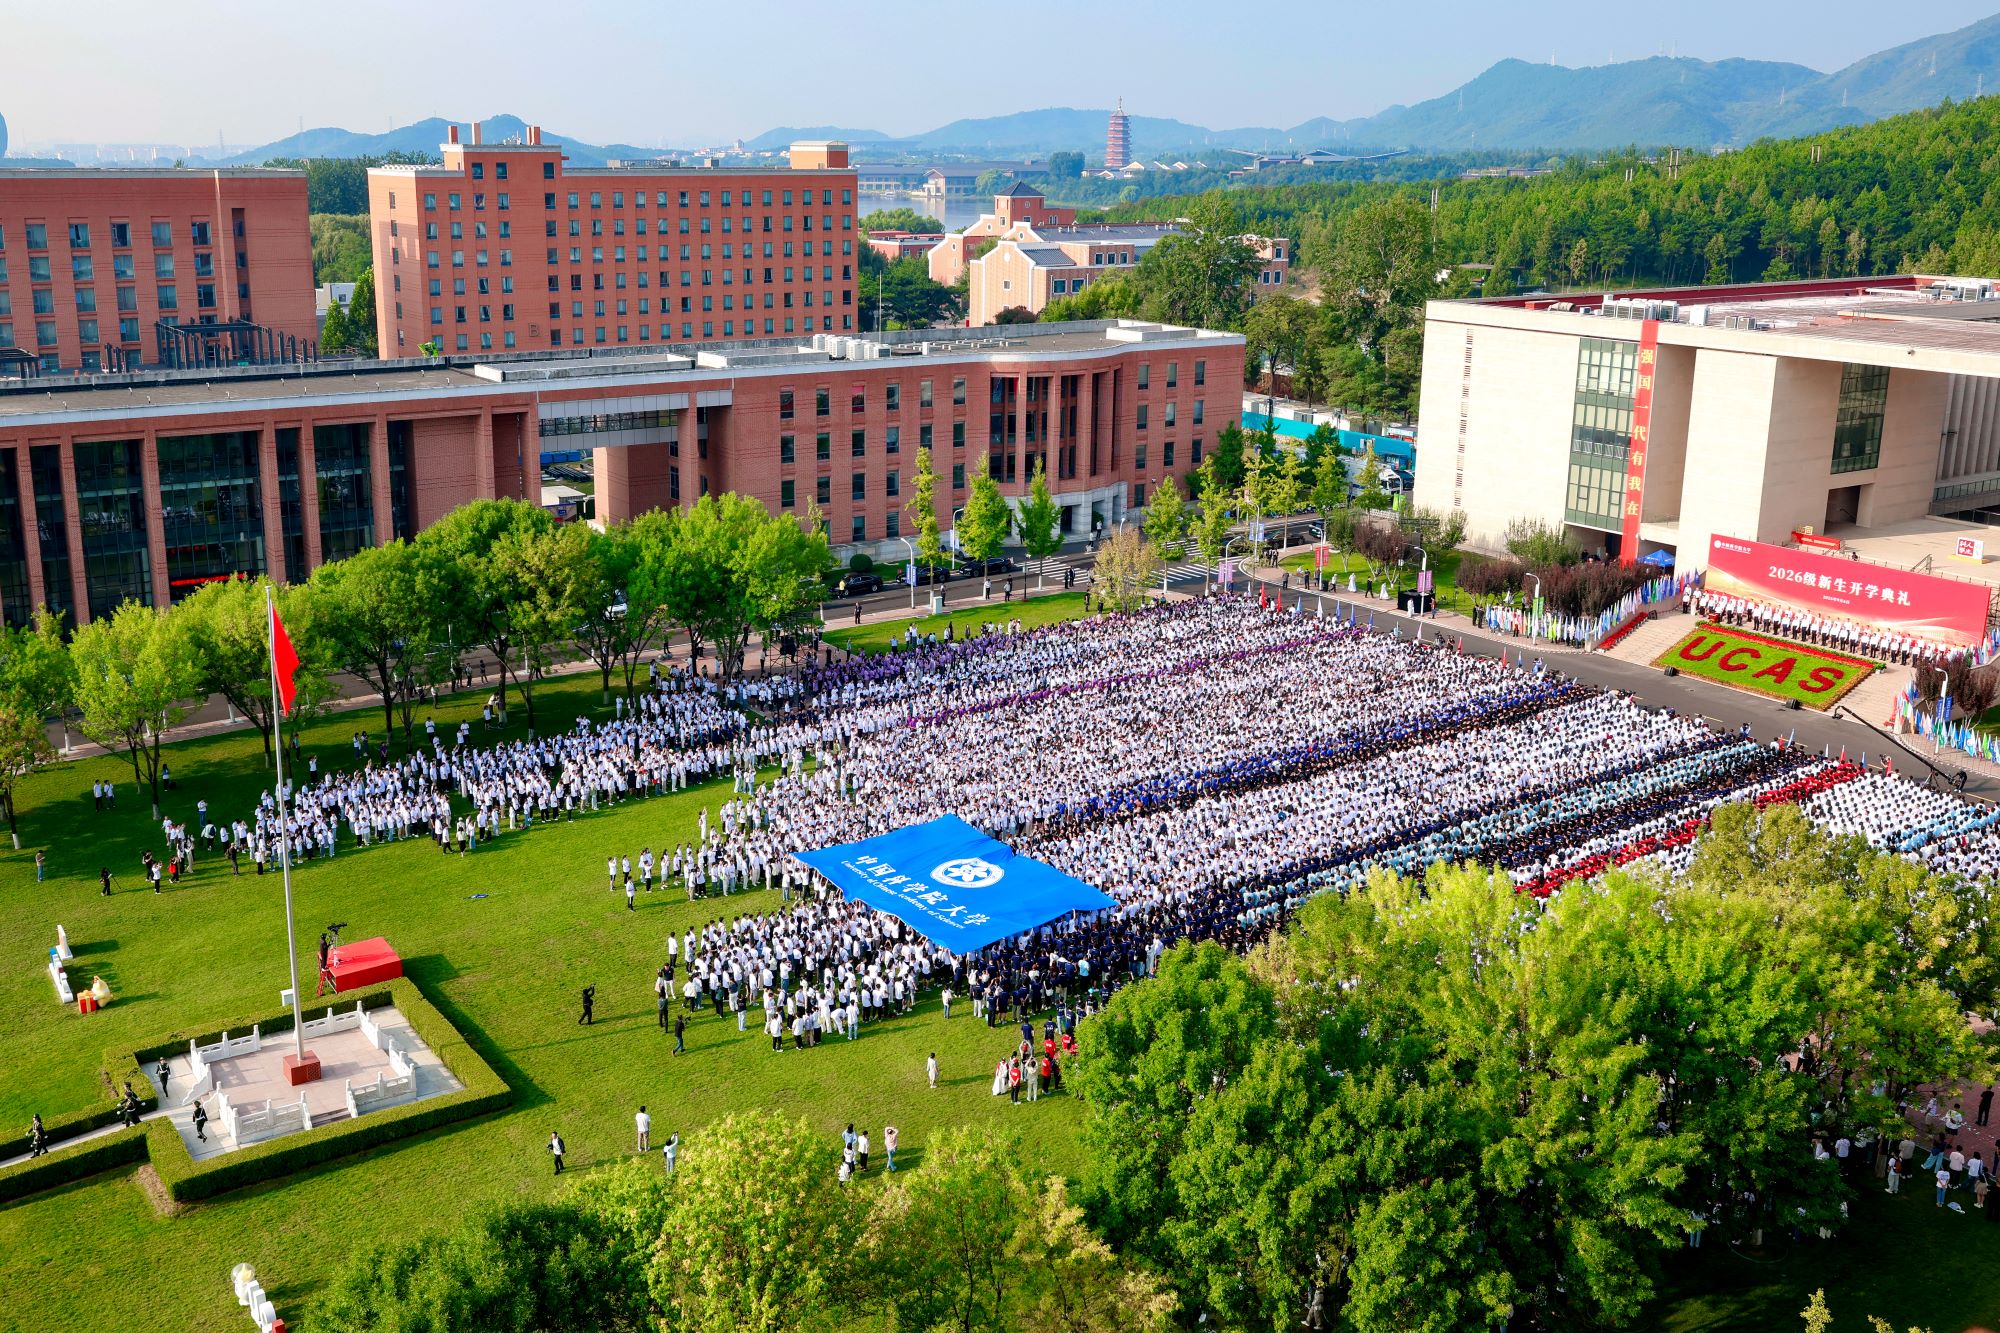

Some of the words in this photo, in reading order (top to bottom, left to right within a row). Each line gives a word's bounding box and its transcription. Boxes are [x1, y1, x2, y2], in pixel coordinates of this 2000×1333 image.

[528, 323, 539, 338] B
[1626, 349, 1654, 516] 强国一代有我在
[1768, 565, 1911, 606] 2026级新生开学典礼
[1679, 635, 1845, 693] UCAS
[855, 855, 991, 926] 中国科学院大学
